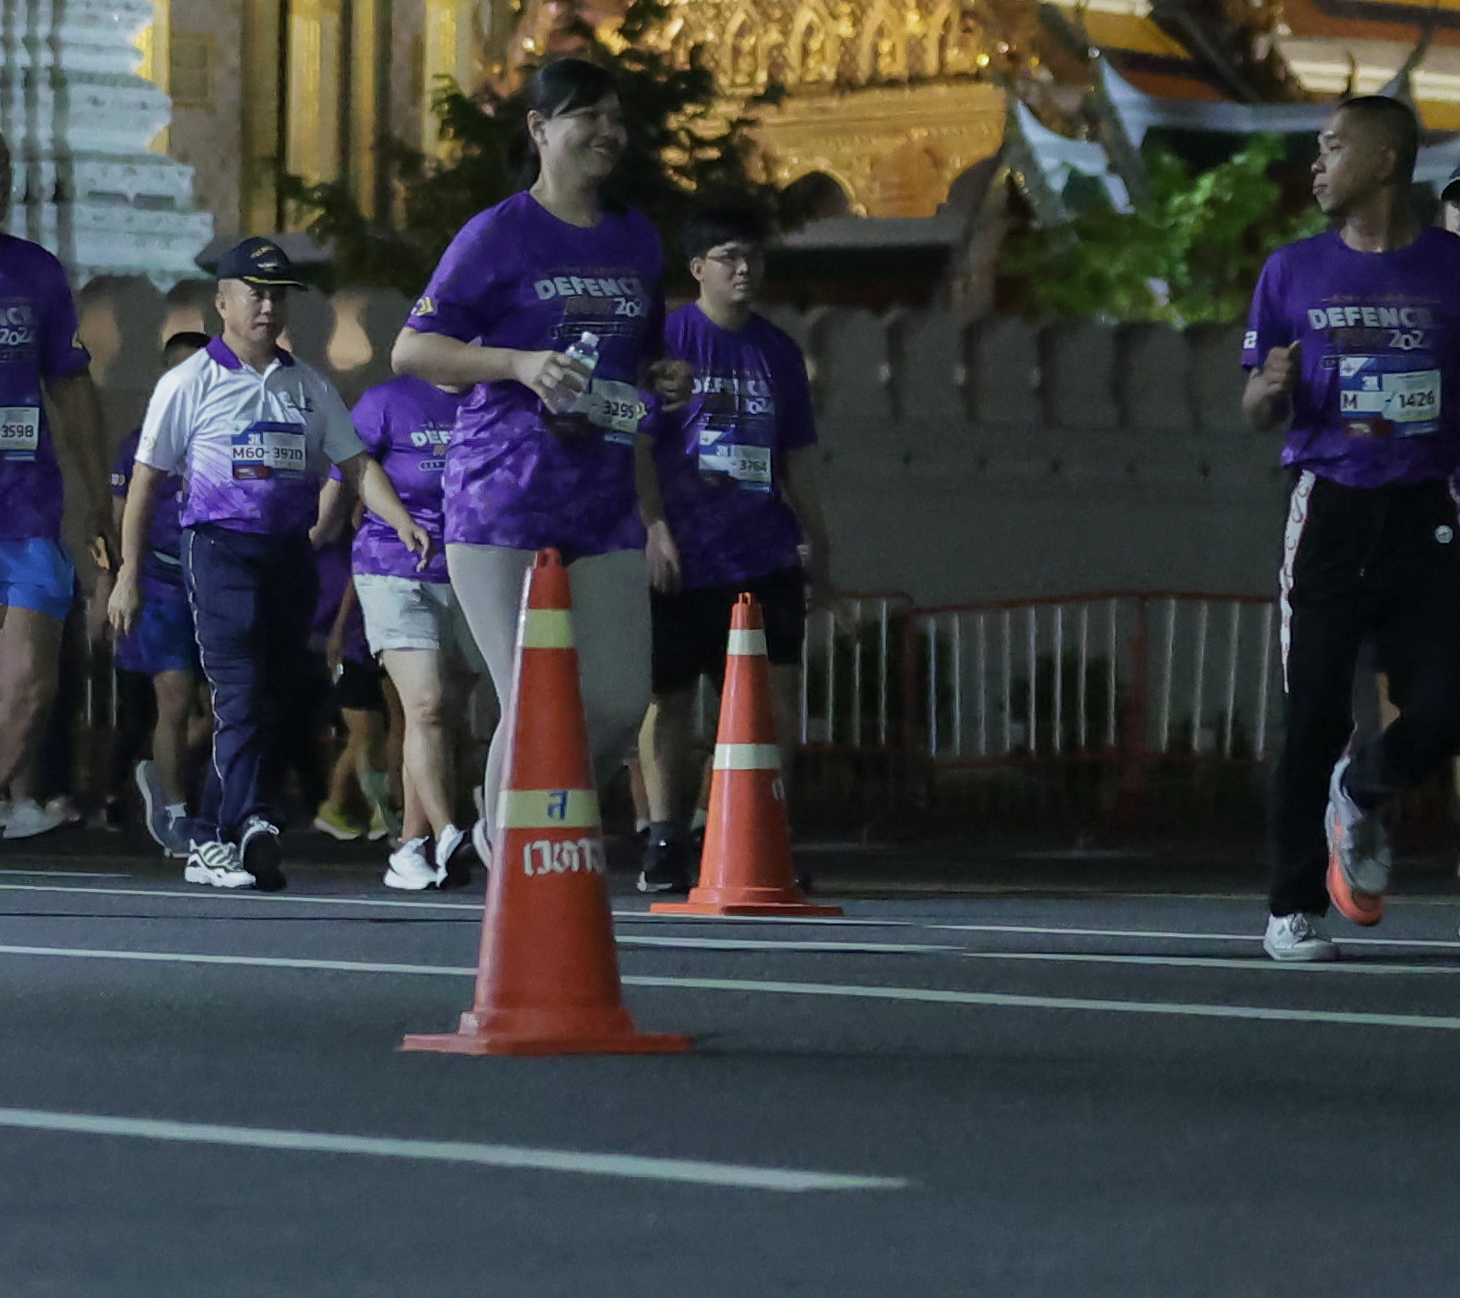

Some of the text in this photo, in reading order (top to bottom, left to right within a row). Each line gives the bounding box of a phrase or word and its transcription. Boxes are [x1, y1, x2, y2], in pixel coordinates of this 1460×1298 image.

[533, 275, 647, 301] DEFENC
[1306, 305, 1433, 331] DEFENC
[1387, 329, 1430, 351] 202
[1341, 393, 1358, 408] M
